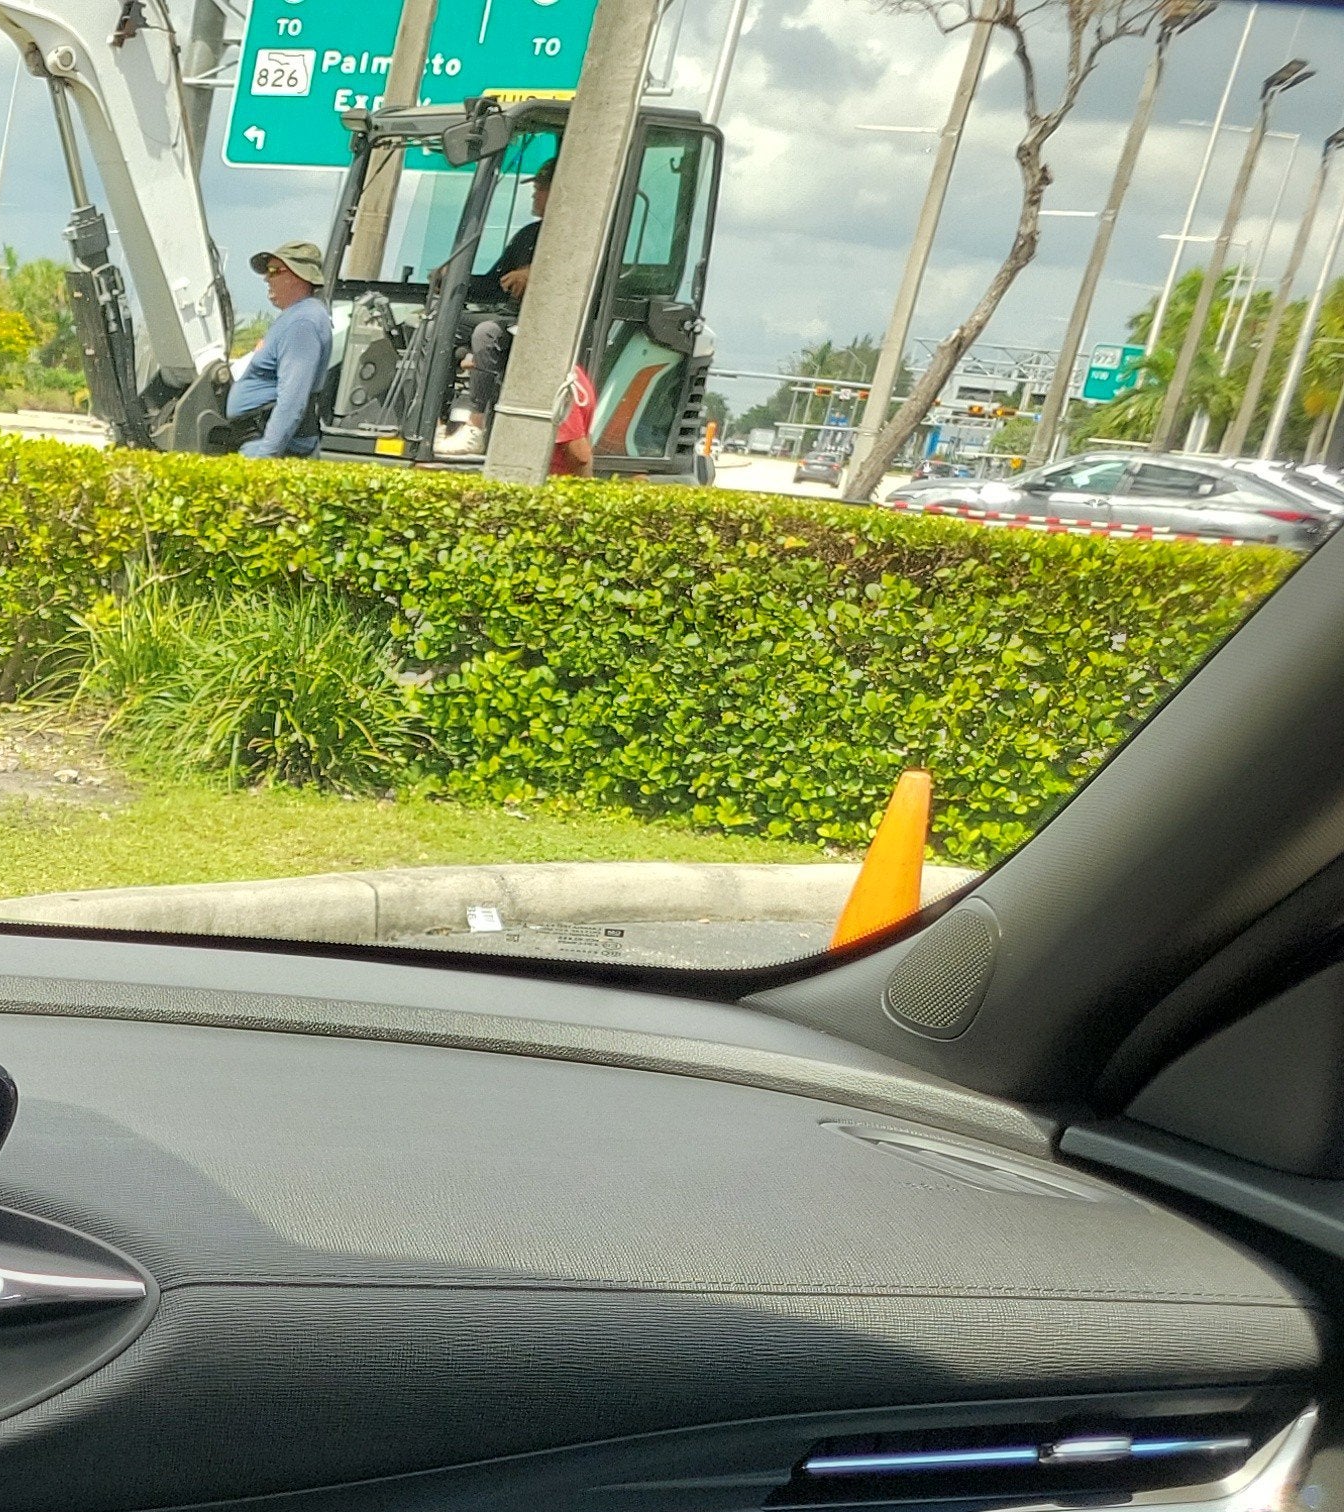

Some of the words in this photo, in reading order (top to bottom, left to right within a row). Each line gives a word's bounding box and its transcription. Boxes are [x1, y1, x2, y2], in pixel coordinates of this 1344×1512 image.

[276, 17, 303, 36] TO
[532, 37, 561, 57] TO
[321, 50, 462, 77] Palmto
[256, 68, 299, 88] 826
